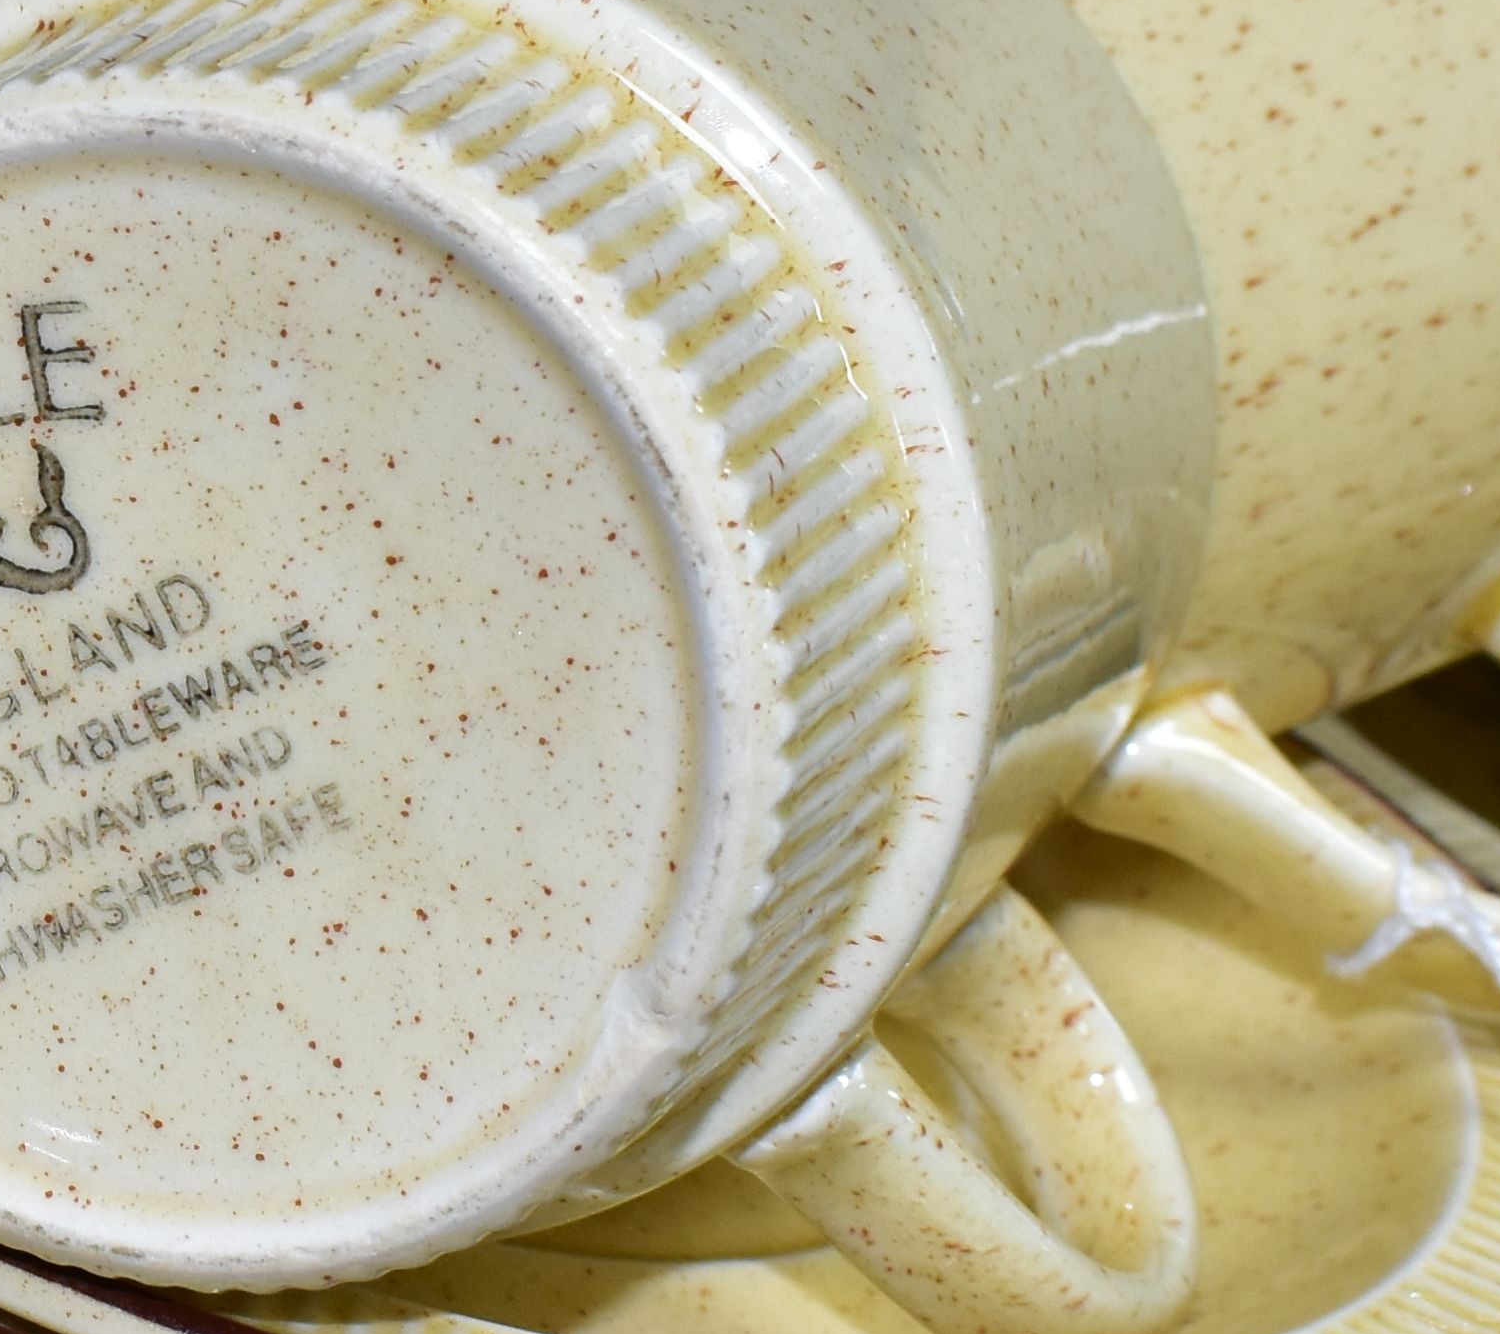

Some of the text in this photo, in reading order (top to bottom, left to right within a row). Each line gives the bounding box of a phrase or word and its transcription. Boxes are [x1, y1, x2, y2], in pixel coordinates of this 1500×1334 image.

[19, 624, 328, 786] TABLEWARE
[190, 725, 292, 801] AND
[221, 782, 354, 876] SAFE
